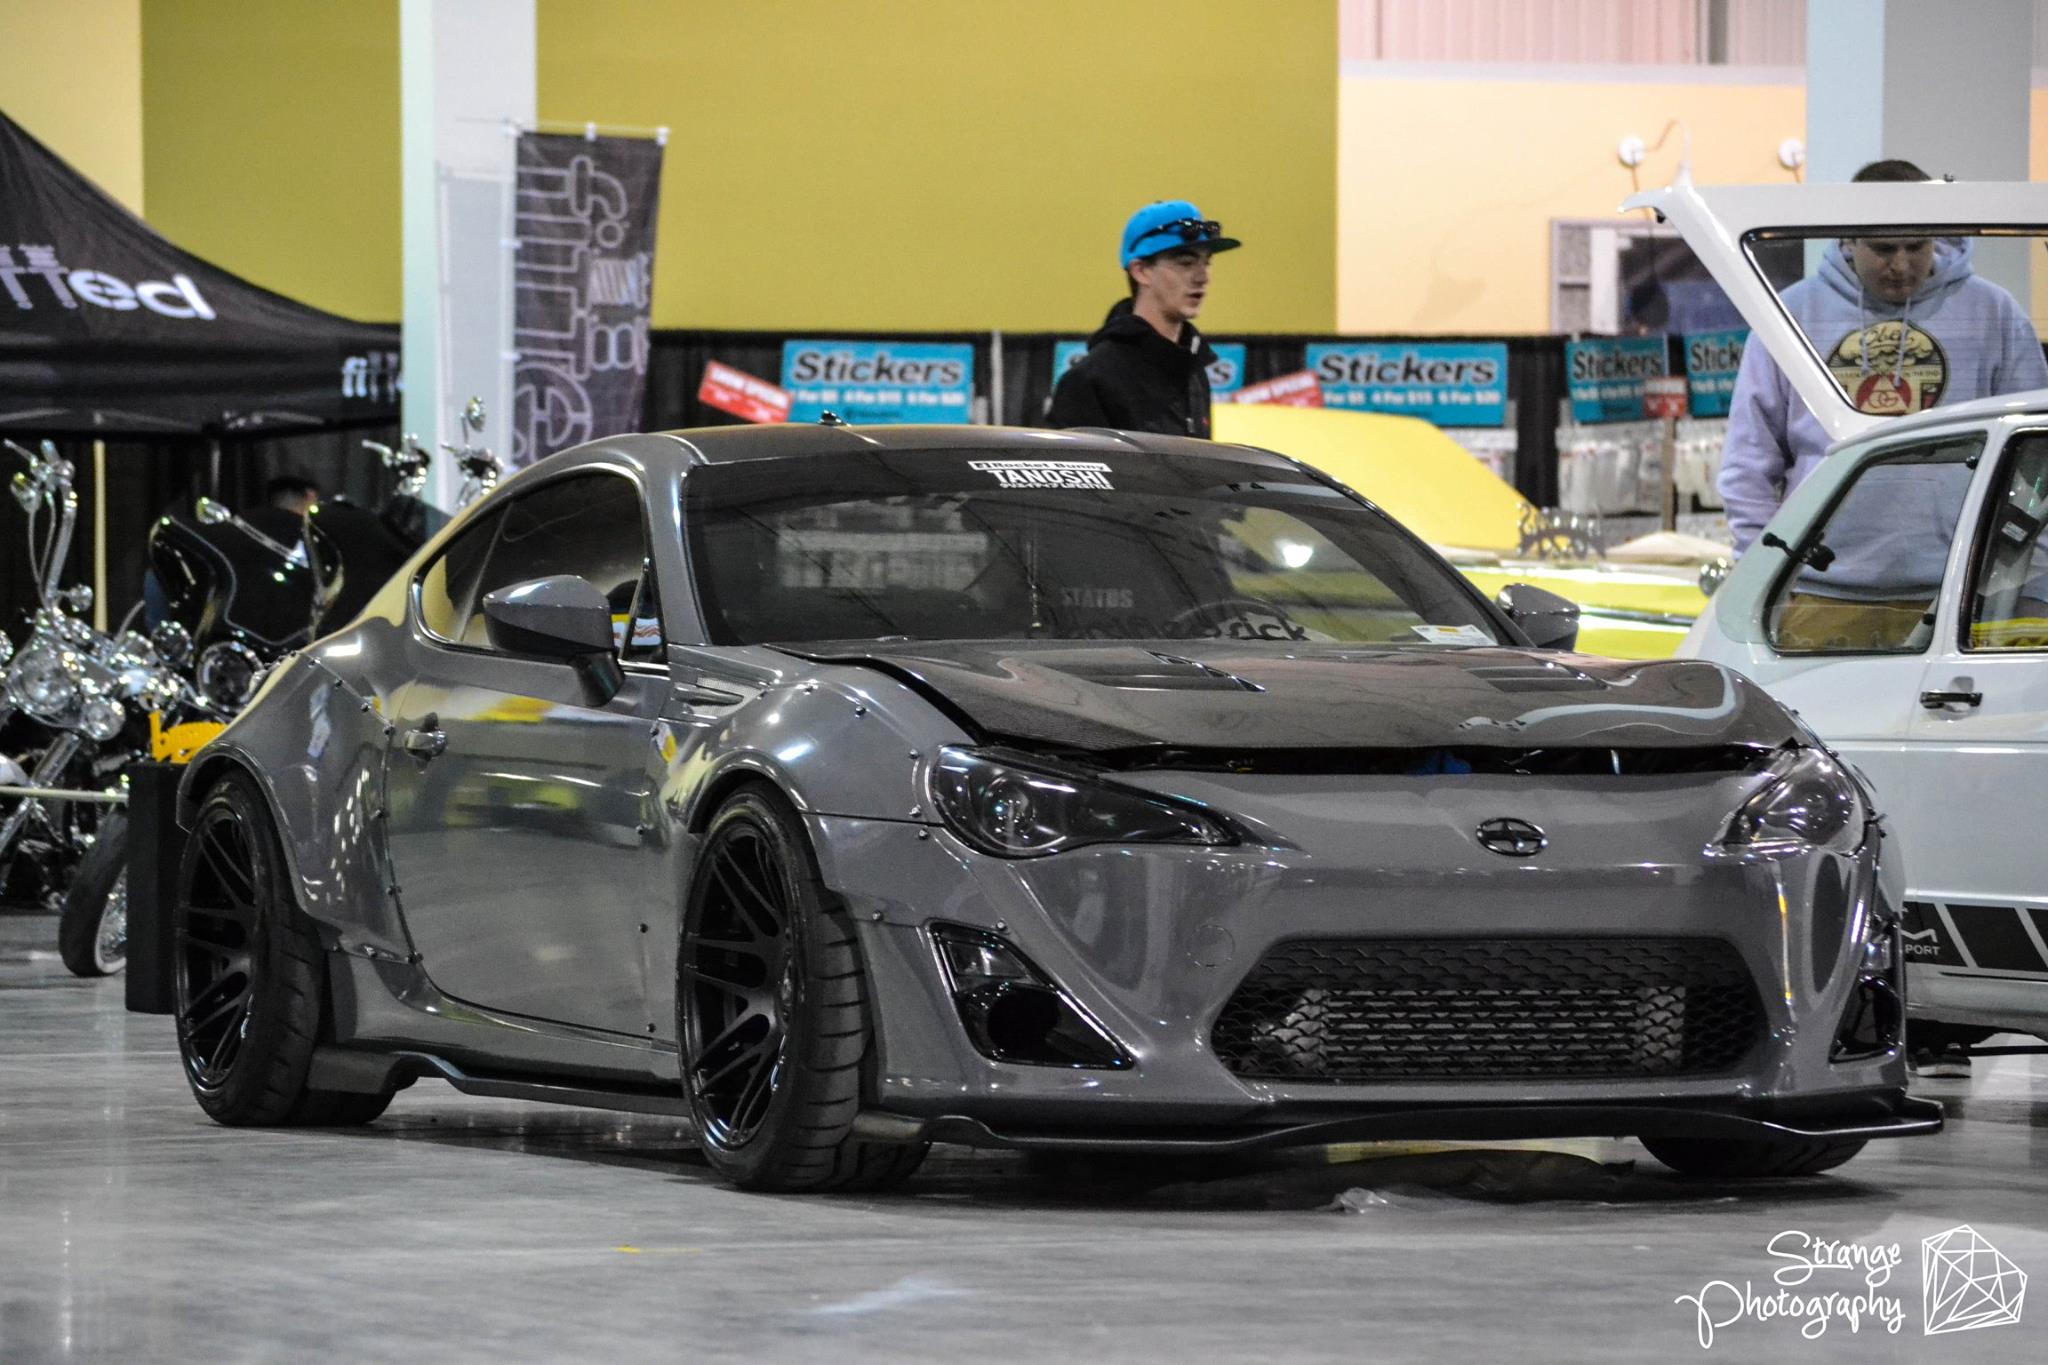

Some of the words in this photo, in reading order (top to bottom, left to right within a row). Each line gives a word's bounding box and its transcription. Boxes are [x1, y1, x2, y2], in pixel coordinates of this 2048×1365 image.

[793, 351, 962, 386] Stickers
[1319, 350, 1497, 386] Stickers
[1573, 350, 1663, 380] Stickers
[986, 469, 1112, 486] TANOSHI
